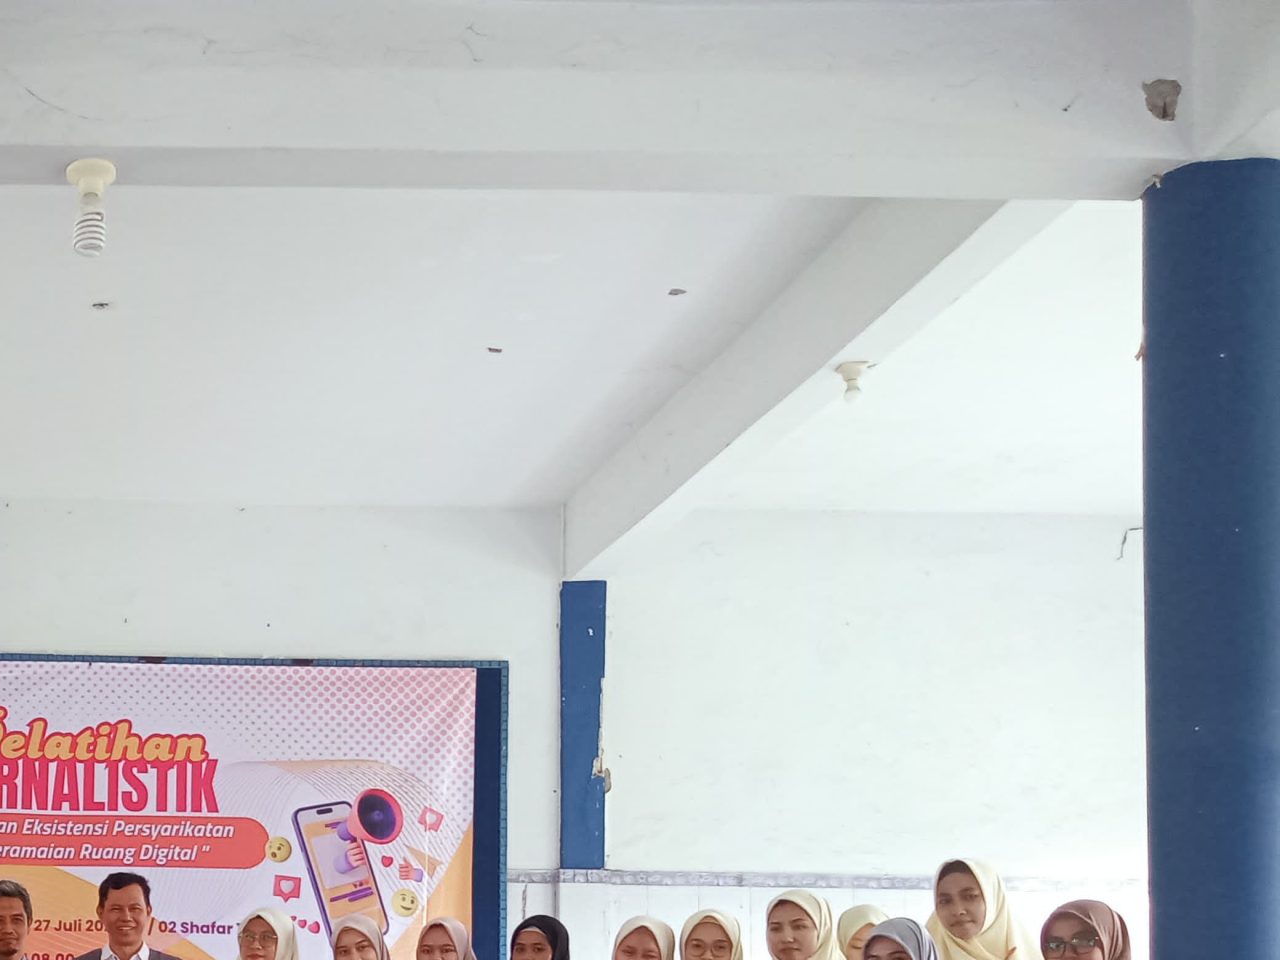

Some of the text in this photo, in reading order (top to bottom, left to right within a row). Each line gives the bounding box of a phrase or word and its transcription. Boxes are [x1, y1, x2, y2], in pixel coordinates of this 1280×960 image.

[22, 818, 109, 836] Eksistensi
[112, 820, 234, 840] Persyarikatan
[79, 844, 136, 864] Ruang
[34, 920, 51, 932] 27
[54, 919, 82, 932] Juli
[159, 921, 176, 933] 02
[180, 922, 234, 934] Shafar
